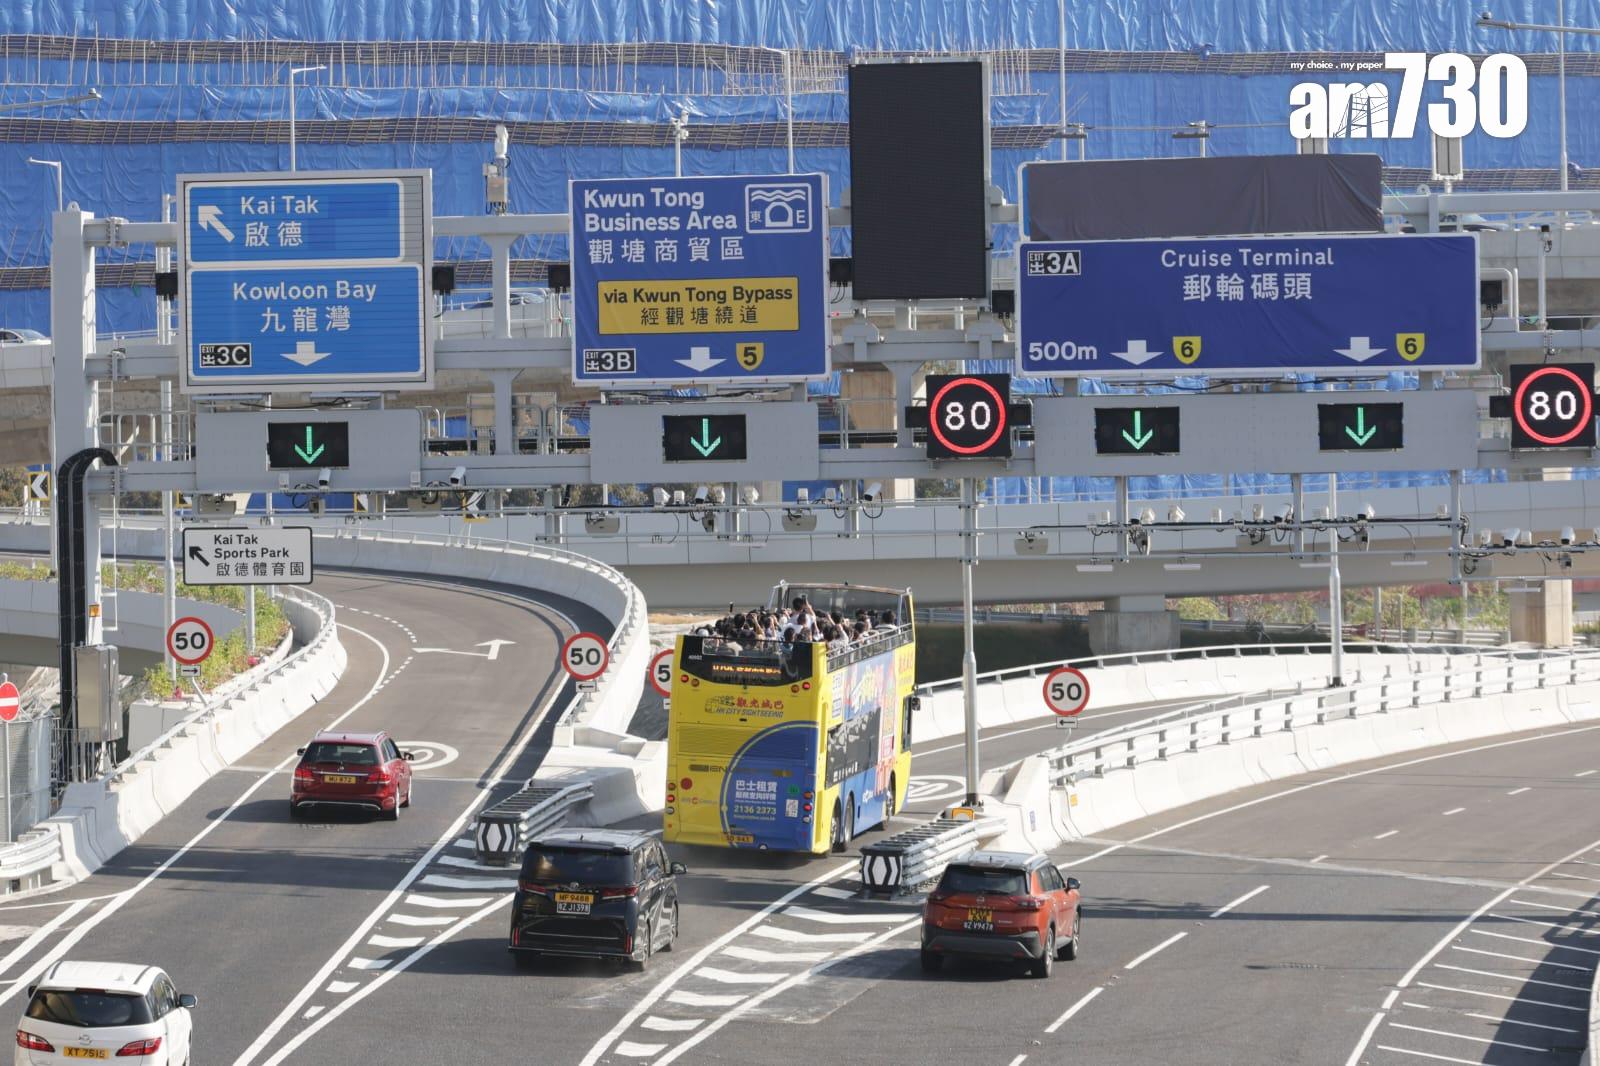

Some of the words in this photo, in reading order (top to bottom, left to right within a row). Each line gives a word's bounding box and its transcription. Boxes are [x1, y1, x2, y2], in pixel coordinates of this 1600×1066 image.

[240, 195, 275, 215] Kai
[281, 195, 319, 214] Tak
[584, 189, 645, 209] Kwun
[650, 187, 704, 209] Tong
[584, 212, 681, 233] Business
[686, 211, 738, 230] Area
[796, 209, 806, 224] E
[588, 235, 745, 265] 觀塘商貿區
[1161, 249, 1232, 268] Cruise
[1238, 247, 1335, 266] Terminal
[1046, 252, 1079, 274] 3A
[233, 281, 328, 301] Kowloon
[336, 280, 377, 302] Bay
[603, 288, 628, 304] via
[633, 287, 681, 303] Kwun
[684, 287, 727, 305] Tong
[732, 285, 793, 304] Bypass
[1182, 272, 1313, 302] 郵輪碼頭
[260, 305, 351, 333] 九龍灣
[640, 304, 759, 325] 經觀塘繞道
[217, 345, 248, 365] 3C
[1028, 341, 1098, 361] 500m
[1180, 340, 1194, 358] 6
[1404, 337, 1418, 355] 6
[601, 351, 632, 371] 3B
[743, 346, 759, 367] 5
[1529, 390, 1577, 421] 80
[945, 401, 991, 431] 80
[214, 534, 233, 545] Kai
[236, 534, 258, 545] Tak
[214, 547, 257, 560] Sports
[260, 547, 290, 558] Park
[175, 632, 206, 651] 50
[570, 647, 601, 666] 50
[657, 664, 671, 683] 5
[1051, 682, 1082, 702] 50
[67, 1047, 80, 1056] XT
